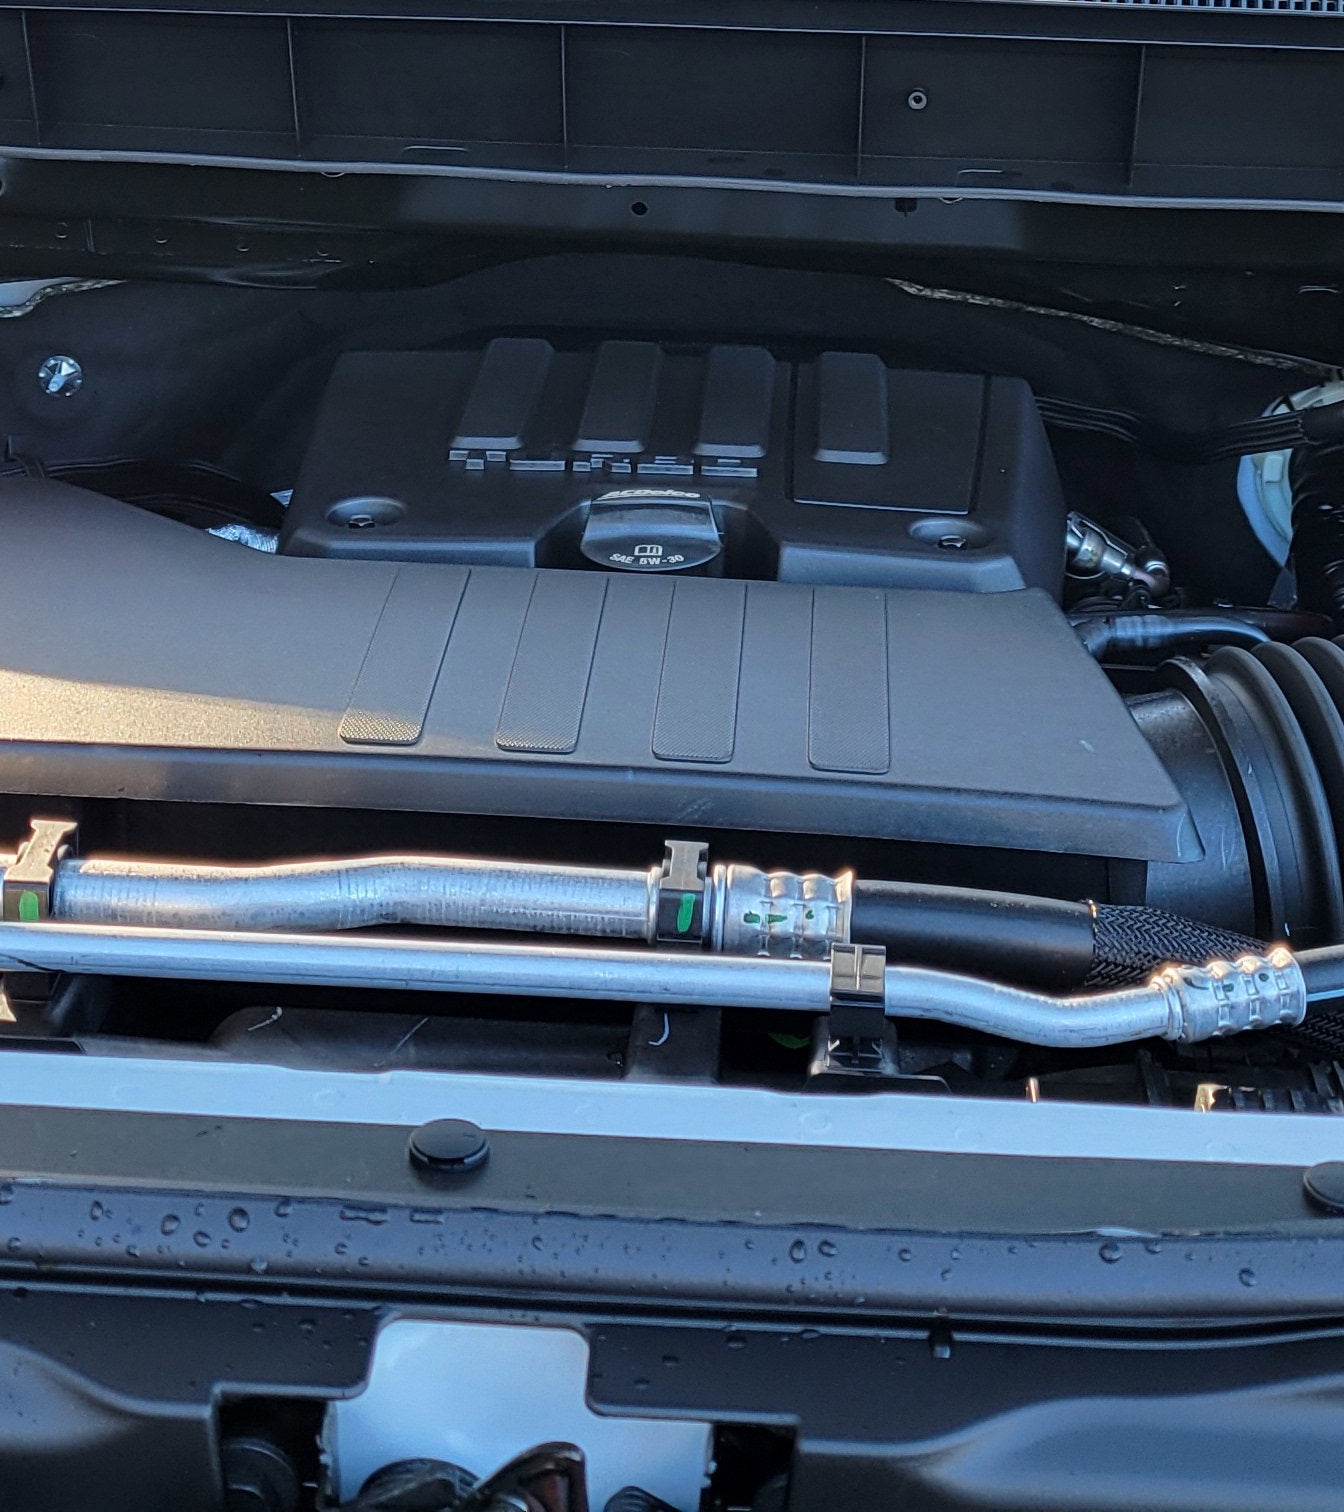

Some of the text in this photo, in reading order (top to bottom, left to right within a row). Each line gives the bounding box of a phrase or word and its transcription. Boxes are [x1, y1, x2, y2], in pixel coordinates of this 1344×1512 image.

[596, 489, 701, 501] ACDelco
[609, 553, 684, 565] SAE 5W-30
